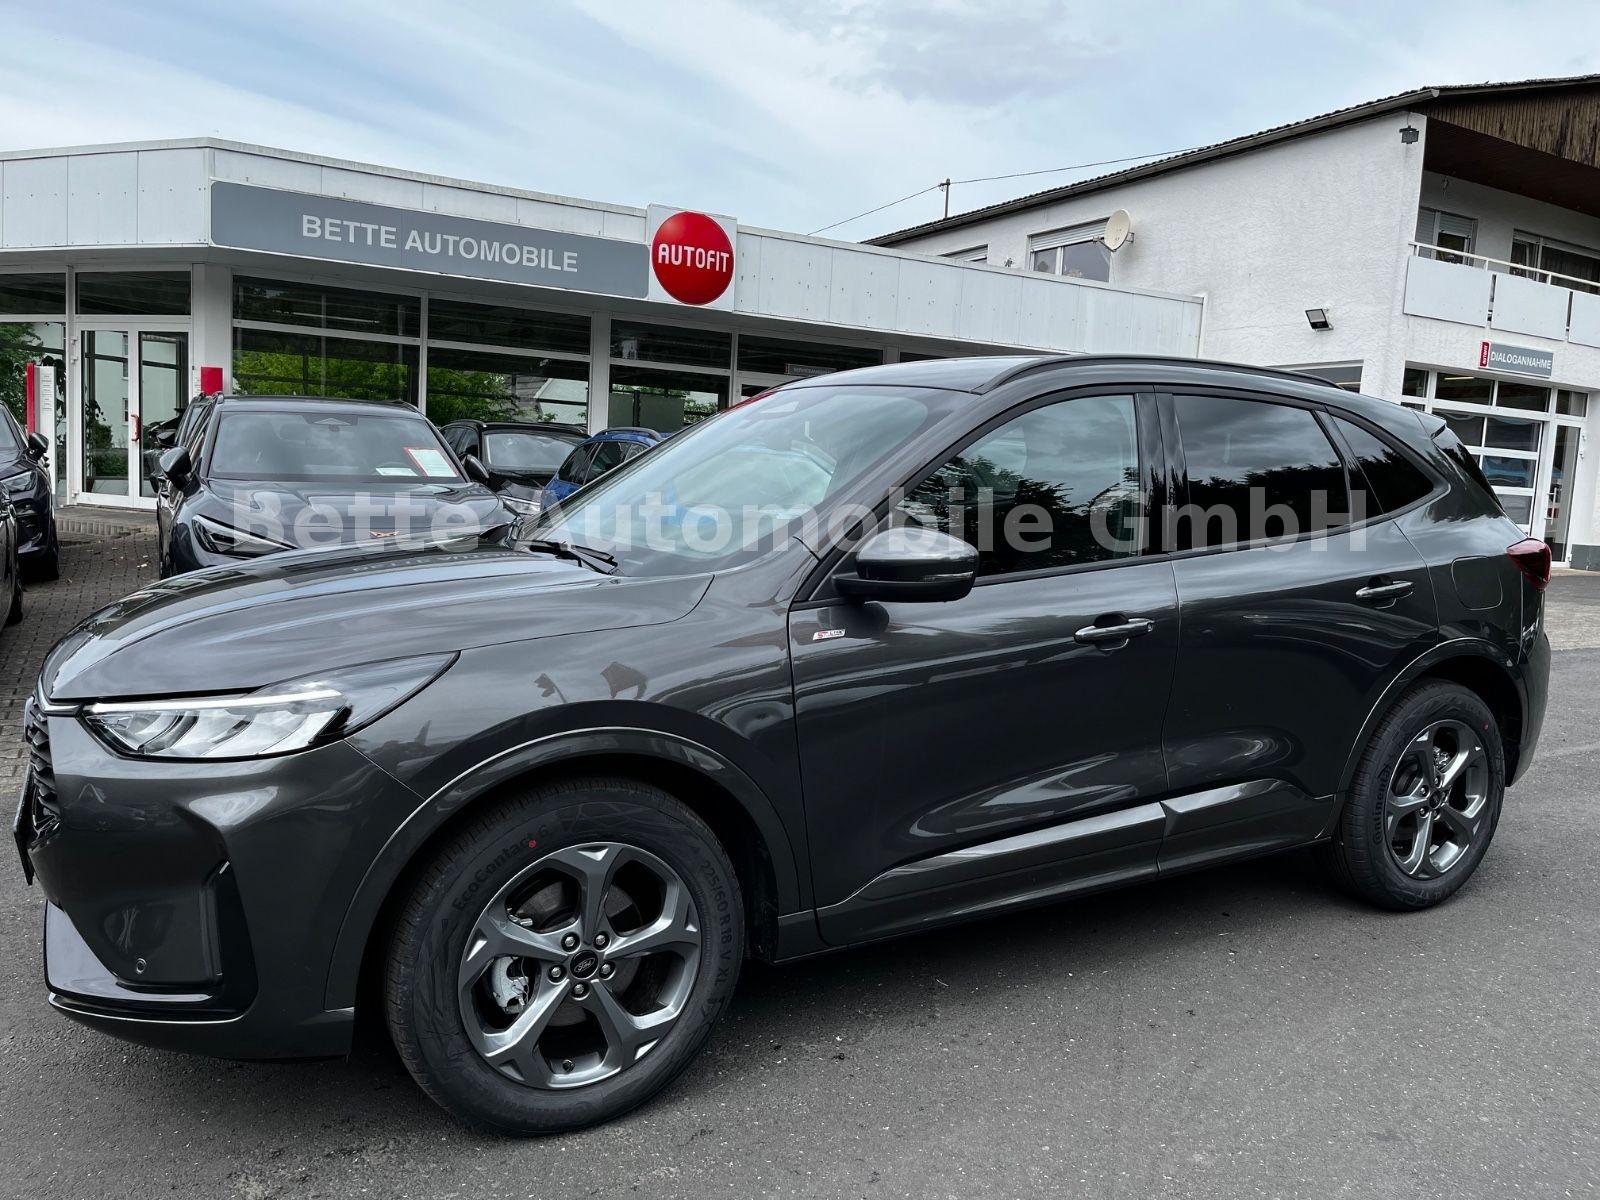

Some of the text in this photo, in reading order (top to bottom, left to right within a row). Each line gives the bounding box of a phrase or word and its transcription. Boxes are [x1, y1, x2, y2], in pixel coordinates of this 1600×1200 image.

[302, 214, 578, 273] BETTE AUTOMOBILE
[657, 243, 730, 273] AUTOFIT
[1491, 352, 1552, 369] DIALOGANNAHME
